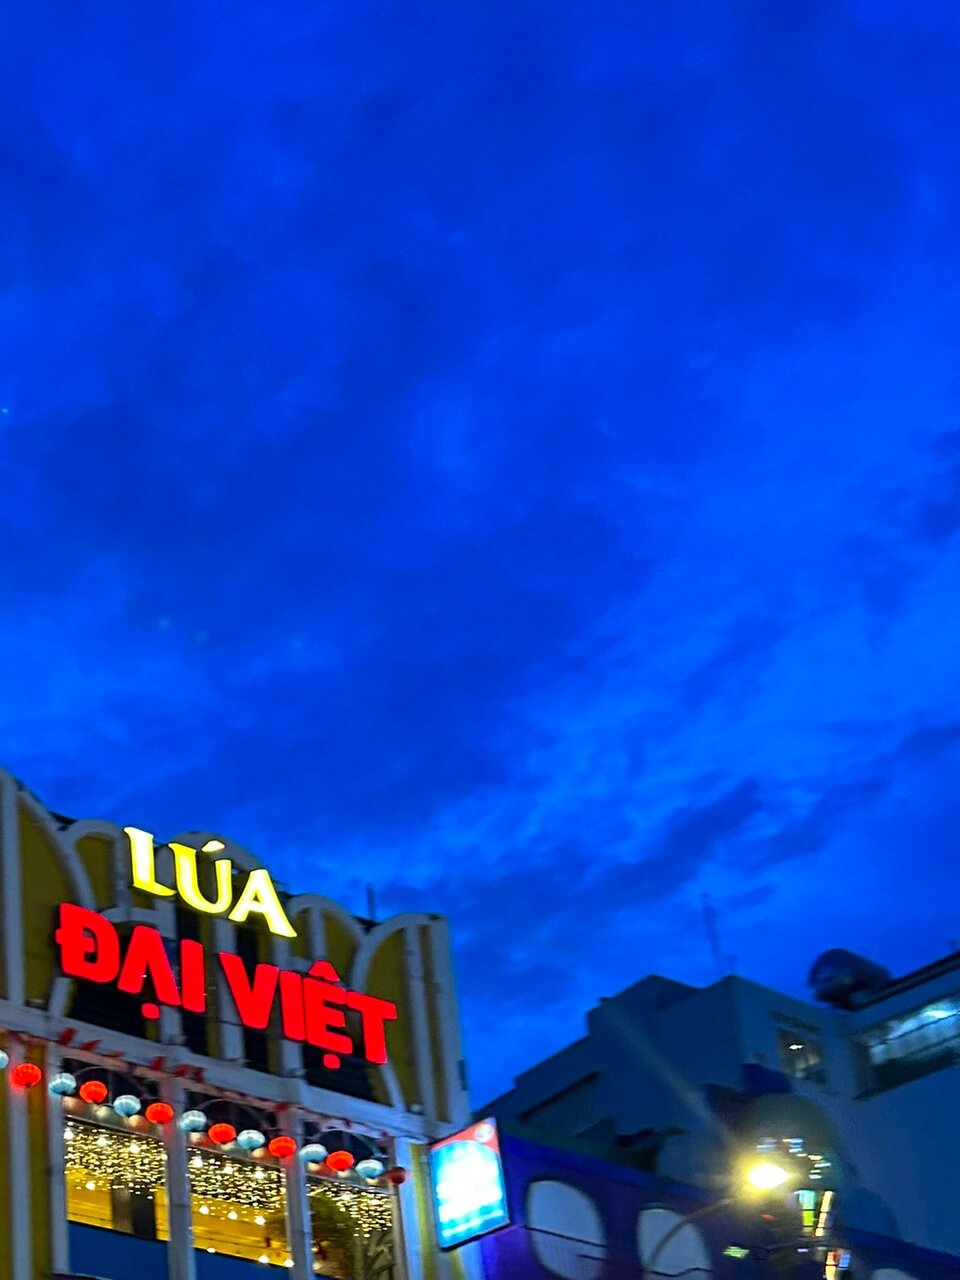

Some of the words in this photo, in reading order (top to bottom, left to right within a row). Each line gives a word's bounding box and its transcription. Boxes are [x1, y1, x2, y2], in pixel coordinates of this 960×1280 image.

[124, 826, 298, 938] LÚA
[55, 902, 207, 1021] ĐẠI
[219, 951, 398, 1070] VIỆT
